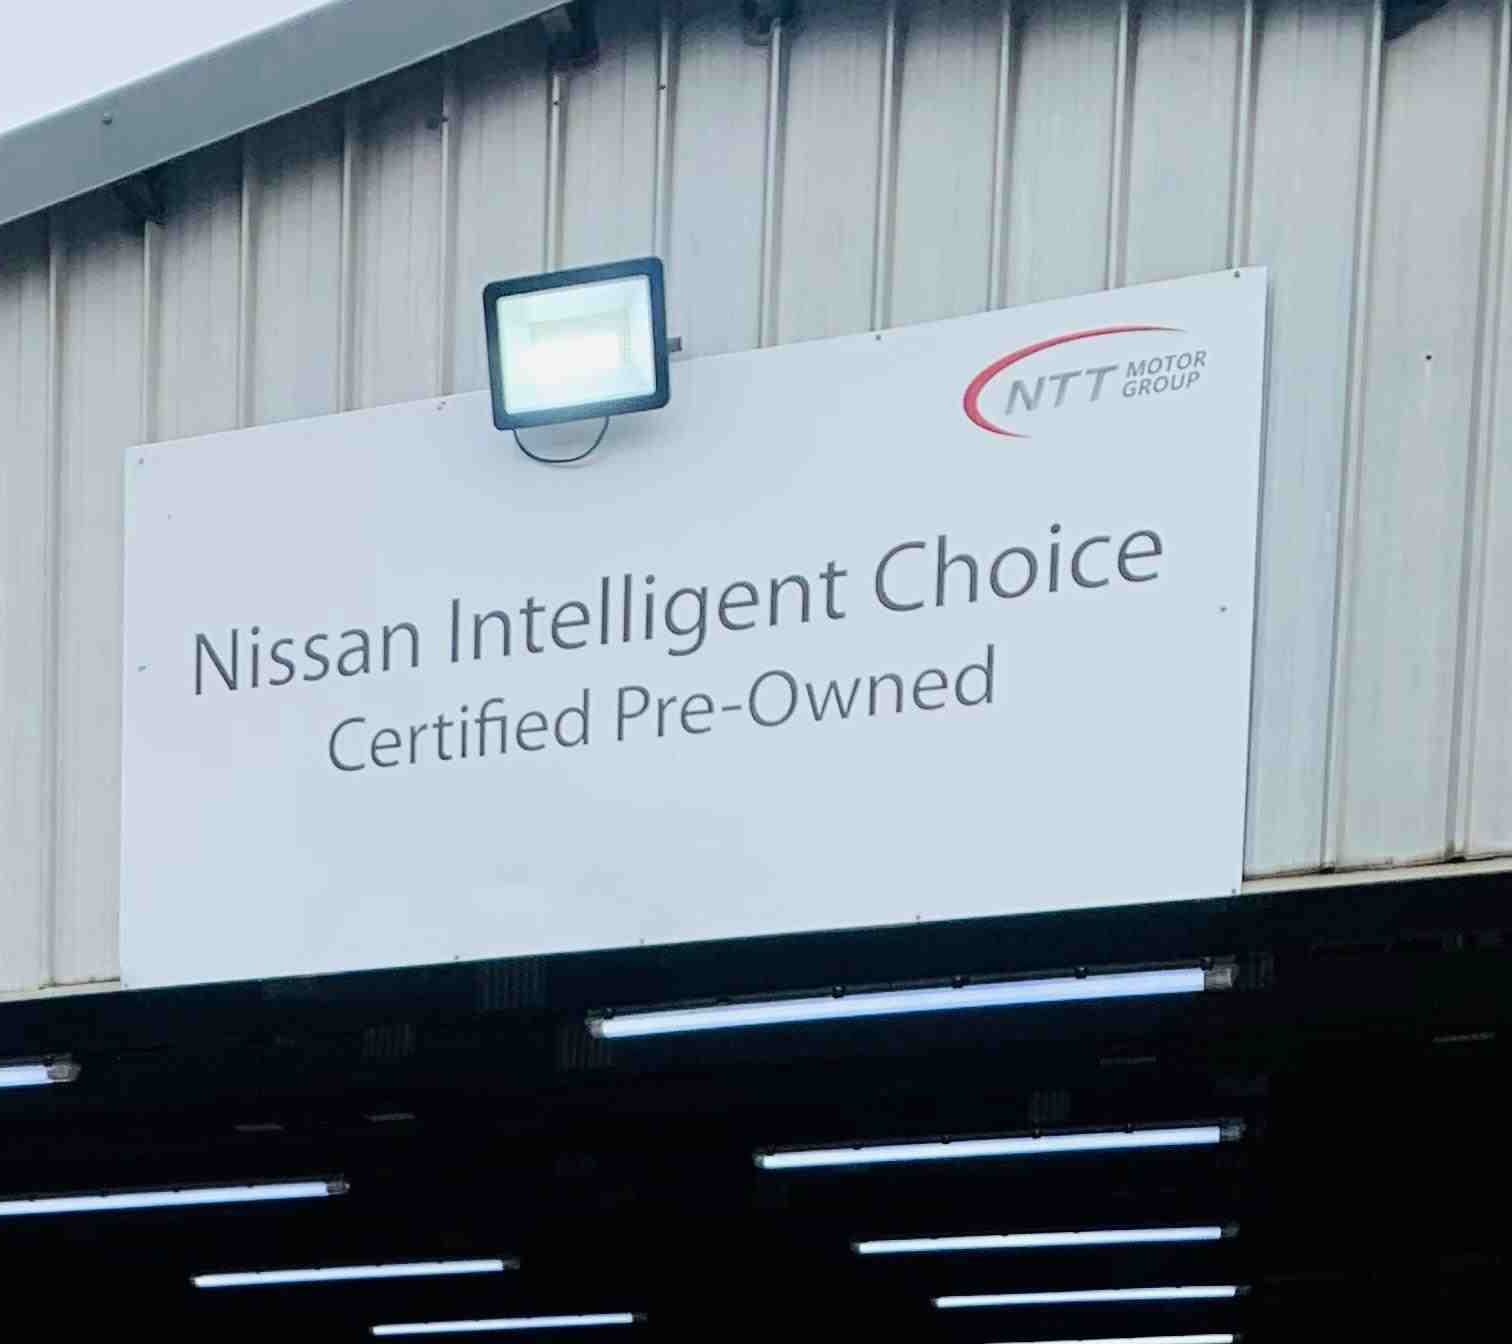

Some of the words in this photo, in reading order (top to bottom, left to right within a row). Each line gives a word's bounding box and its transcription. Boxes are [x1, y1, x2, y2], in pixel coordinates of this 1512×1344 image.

[1121, 370, 1201, 399] GROUP
[1125, 350, 1207, 378] MOTOR
[1004, 365, 1119, 415] NTT
[191, 615, 421, 697] Nissan
[449, 559, 848, 663] Intelligent
[873, 522, 1166, 613] Choice
[327, 689, 593, 774] Certified
[614, 645, 998, 745] Pre-Owned
